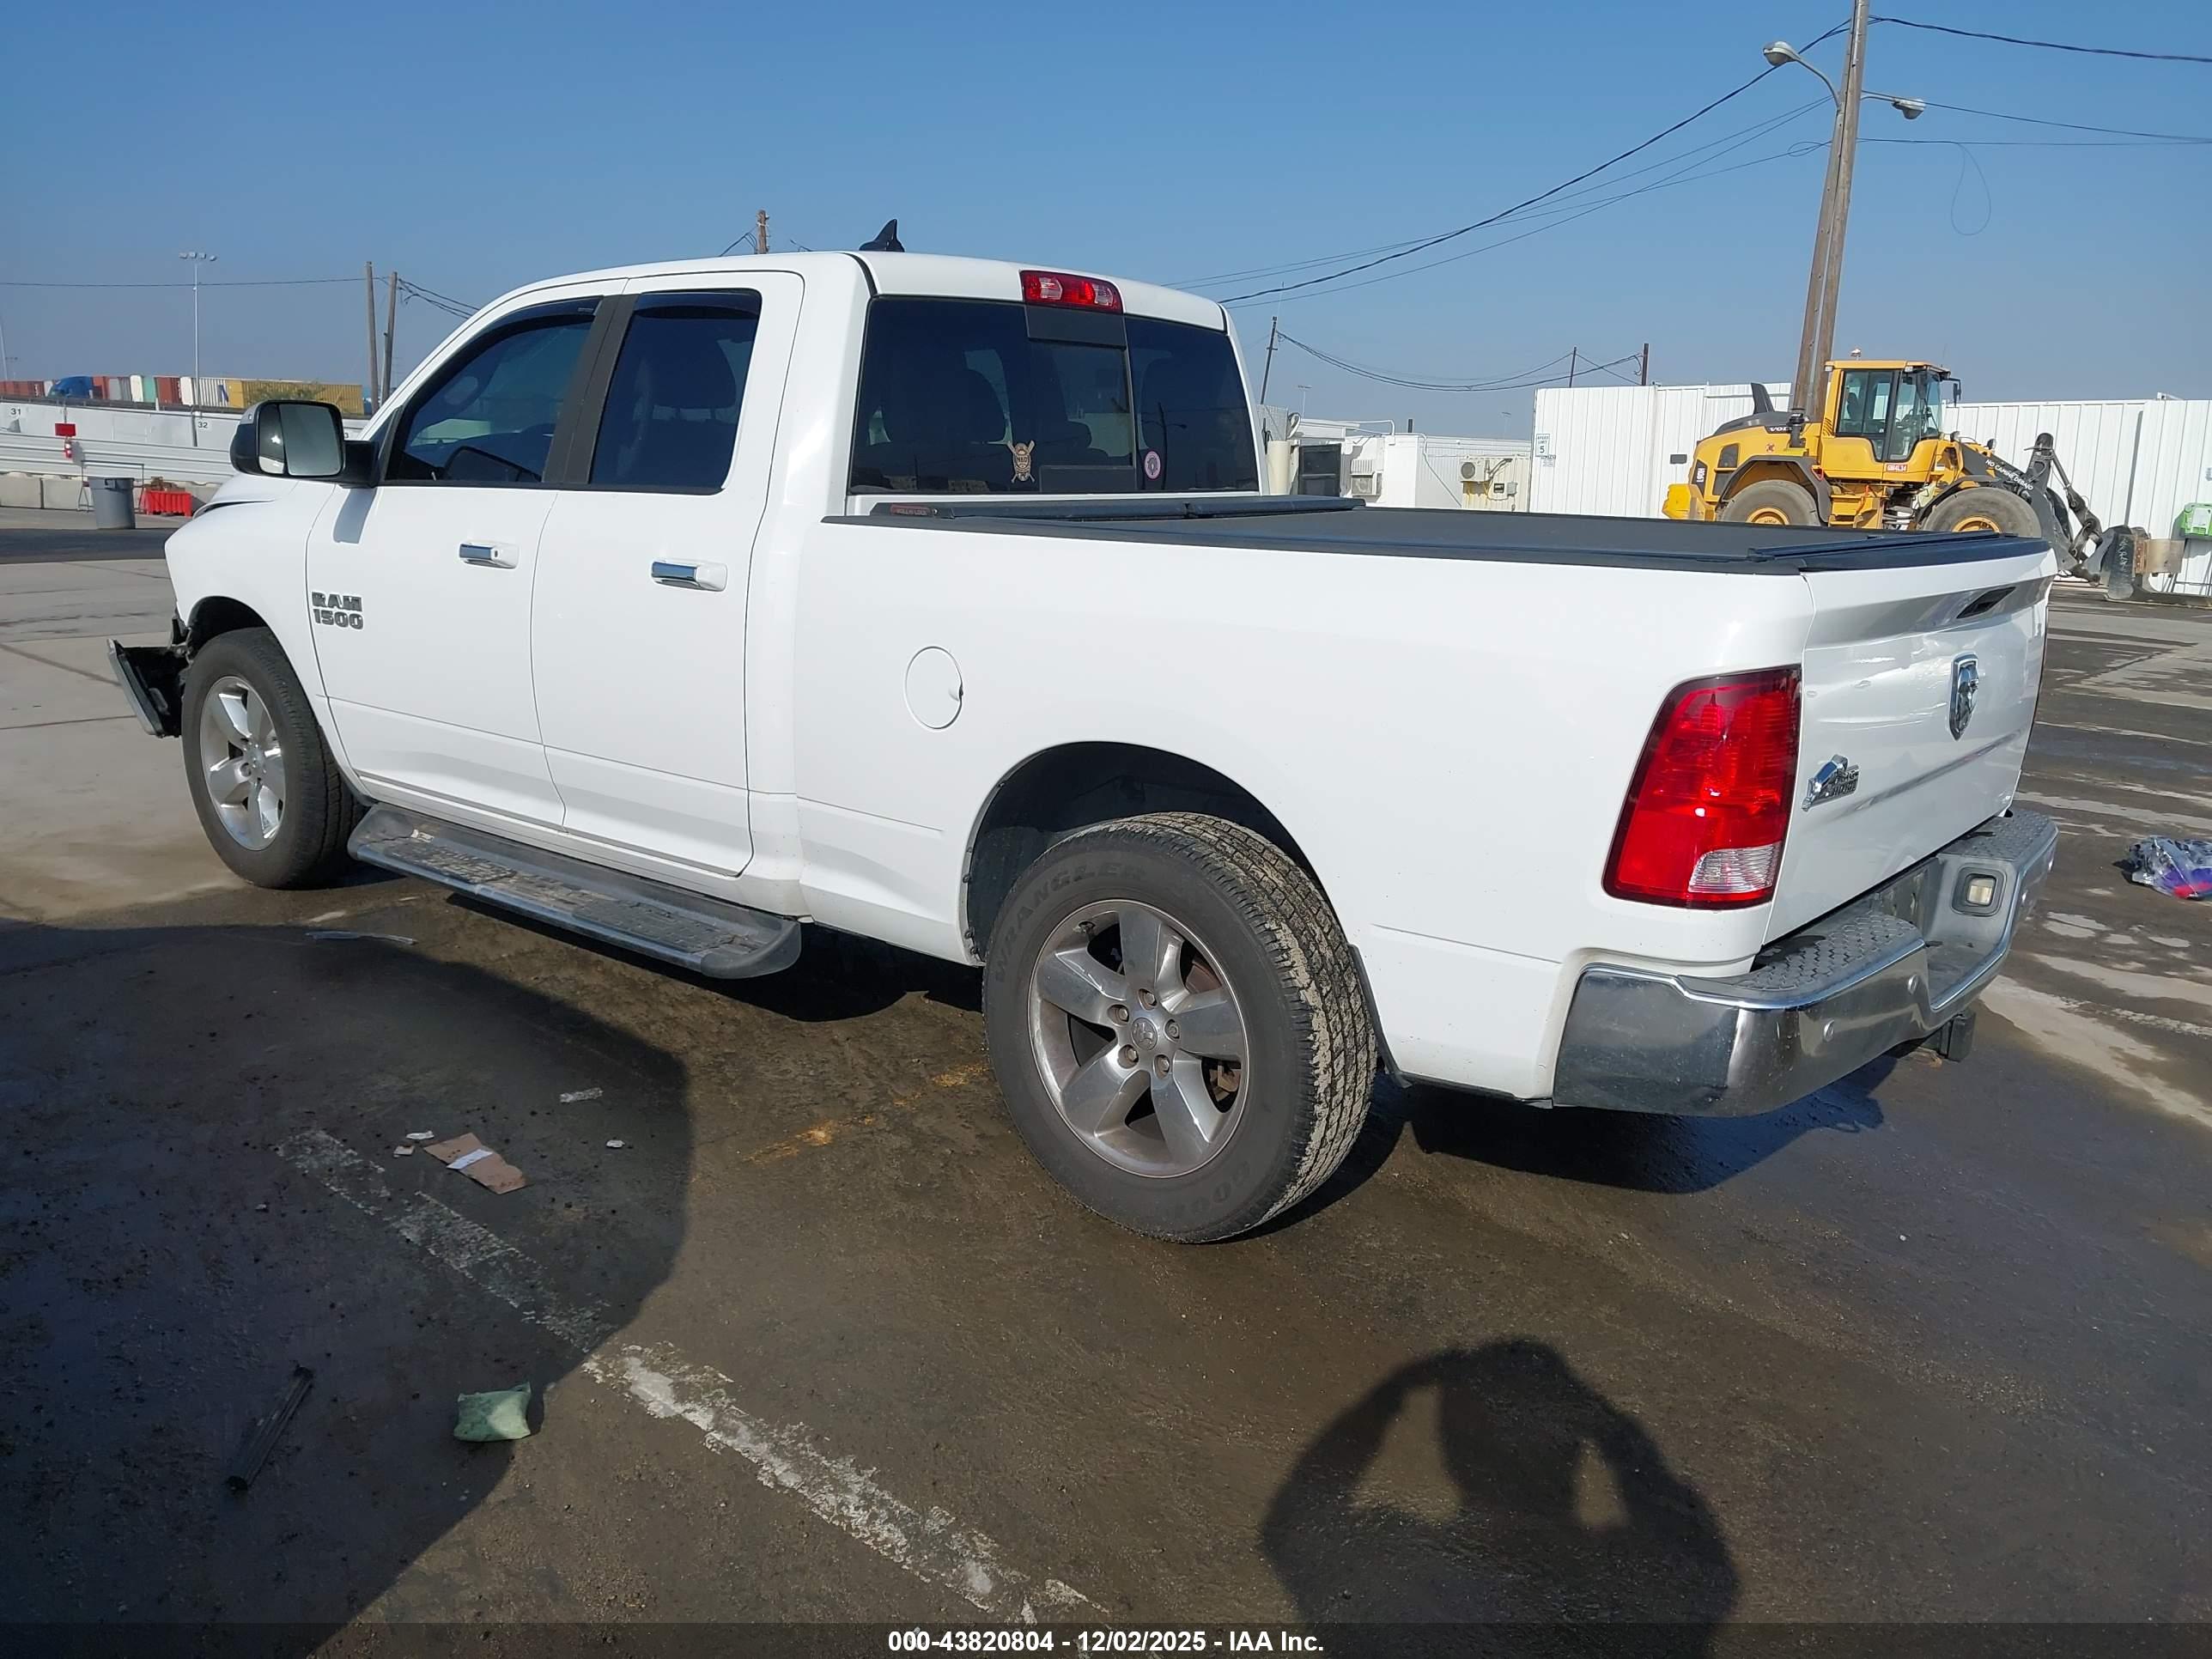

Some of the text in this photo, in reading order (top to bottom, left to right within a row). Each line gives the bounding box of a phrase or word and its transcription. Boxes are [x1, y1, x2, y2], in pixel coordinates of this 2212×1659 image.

[10, 407, 21, 416] 31
[1985, 459, 1996, 467] NO
[311, 591, 362, 612] RAM
[313, 608, 364, 630] 1500
